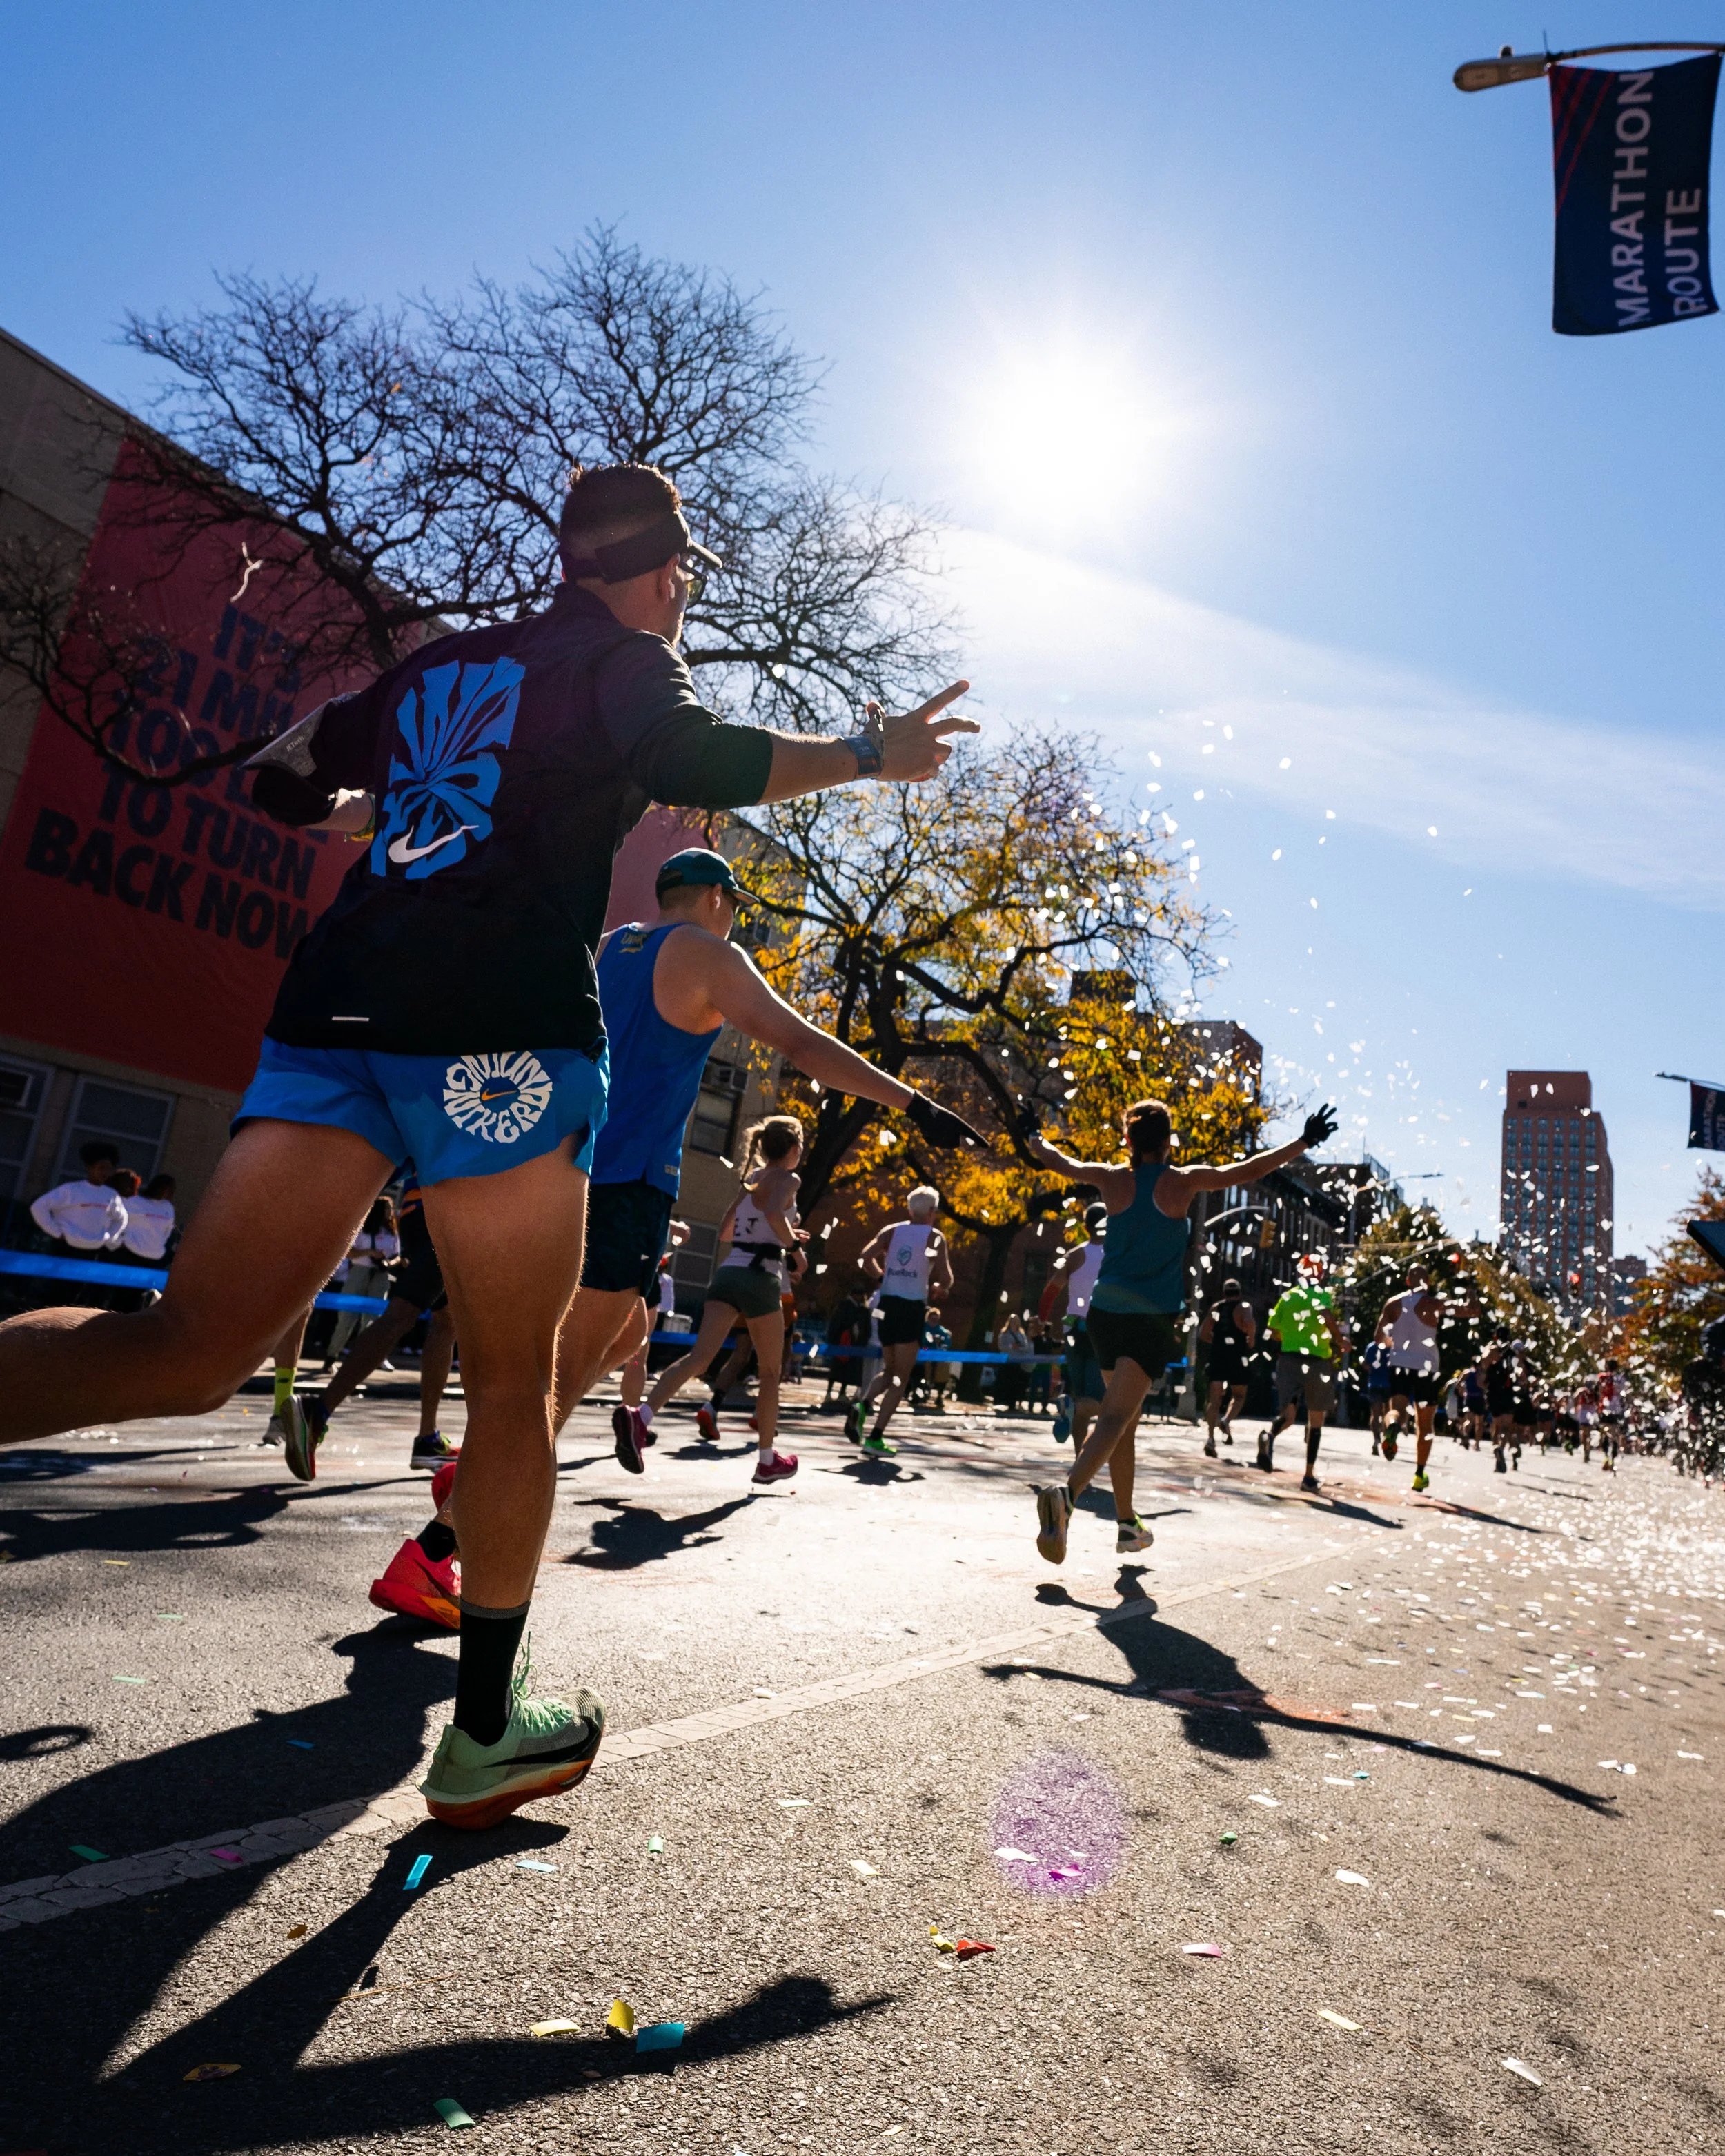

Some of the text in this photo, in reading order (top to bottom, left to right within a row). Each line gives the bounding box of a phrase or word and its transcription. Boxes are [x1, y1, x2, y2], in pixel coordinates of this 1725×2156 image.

[1610, 71, 1655, 326] MARATHON
[1664, 188, 1708, 317] ROUTE
[213, 604, 302, 693] IT'S
[108, 687, 219, 787] TOO
[26, 808, 195, 922] BACK
[98, 760, 172, 838] TO
[182, 795, 316, 901] TURN
